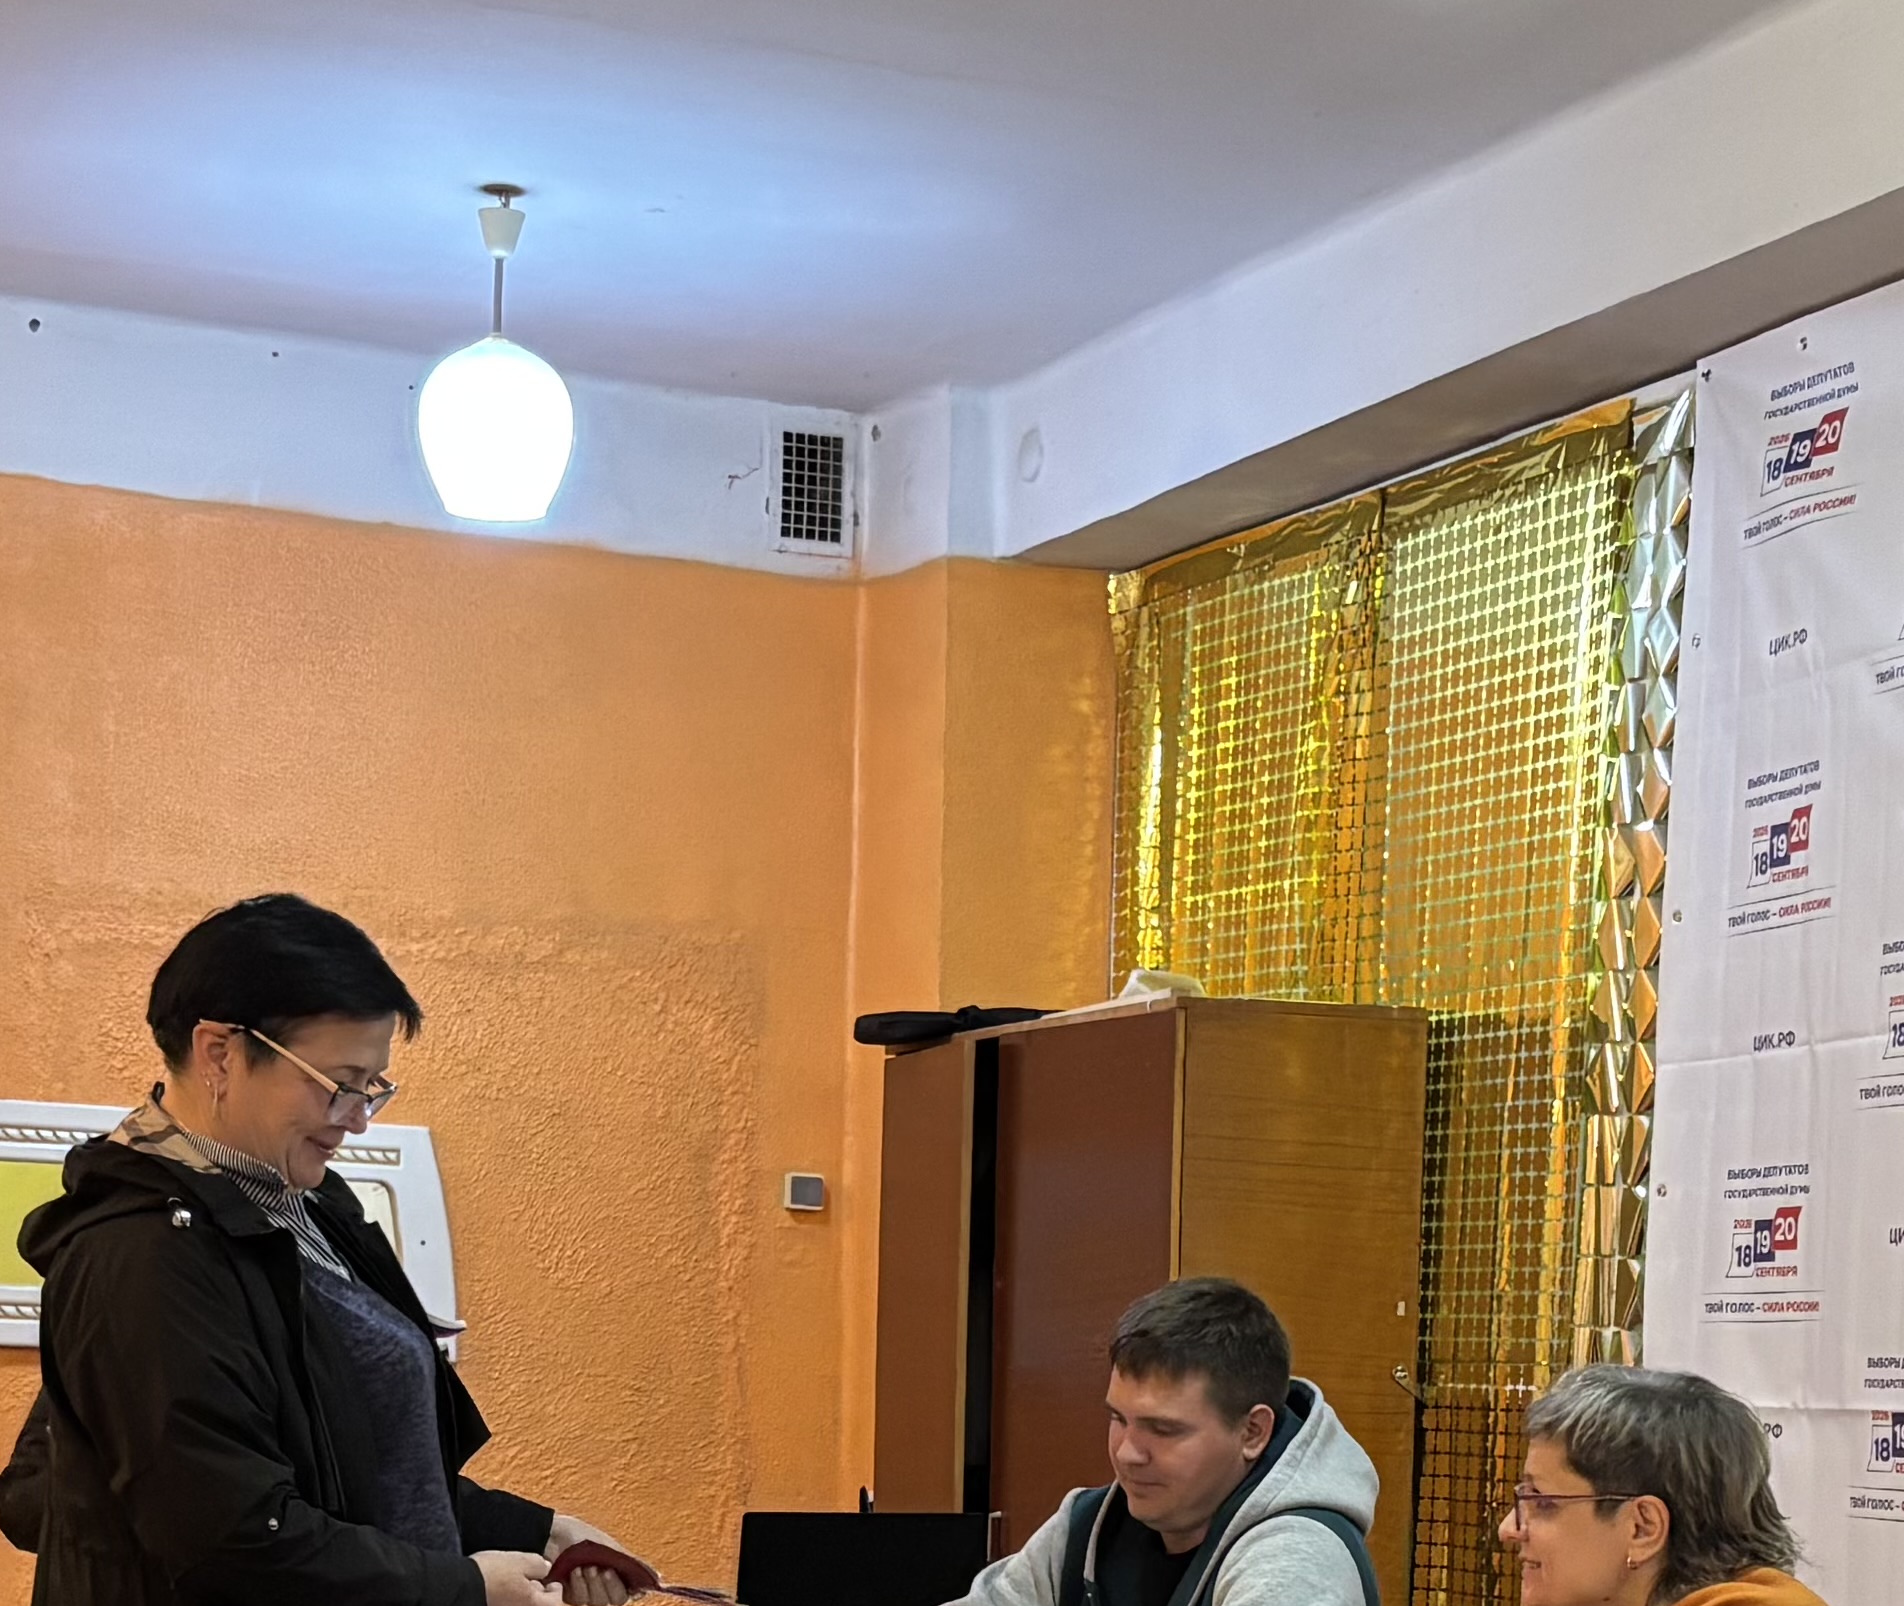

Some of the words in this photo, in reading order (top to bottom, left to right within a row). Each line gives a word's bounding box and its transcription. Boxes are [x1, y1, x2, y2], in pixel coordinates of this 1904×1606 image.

[1754, 851, 1768, 876] 18
[1772, 834, 1787, 859] 19
[1790, 816, 1808, 843] 20
[1735, 1244, 1752, 1267] 18
[1756, 1230, 1770, 1254] 19
[1775, 1217, 1795, 1241] 20
